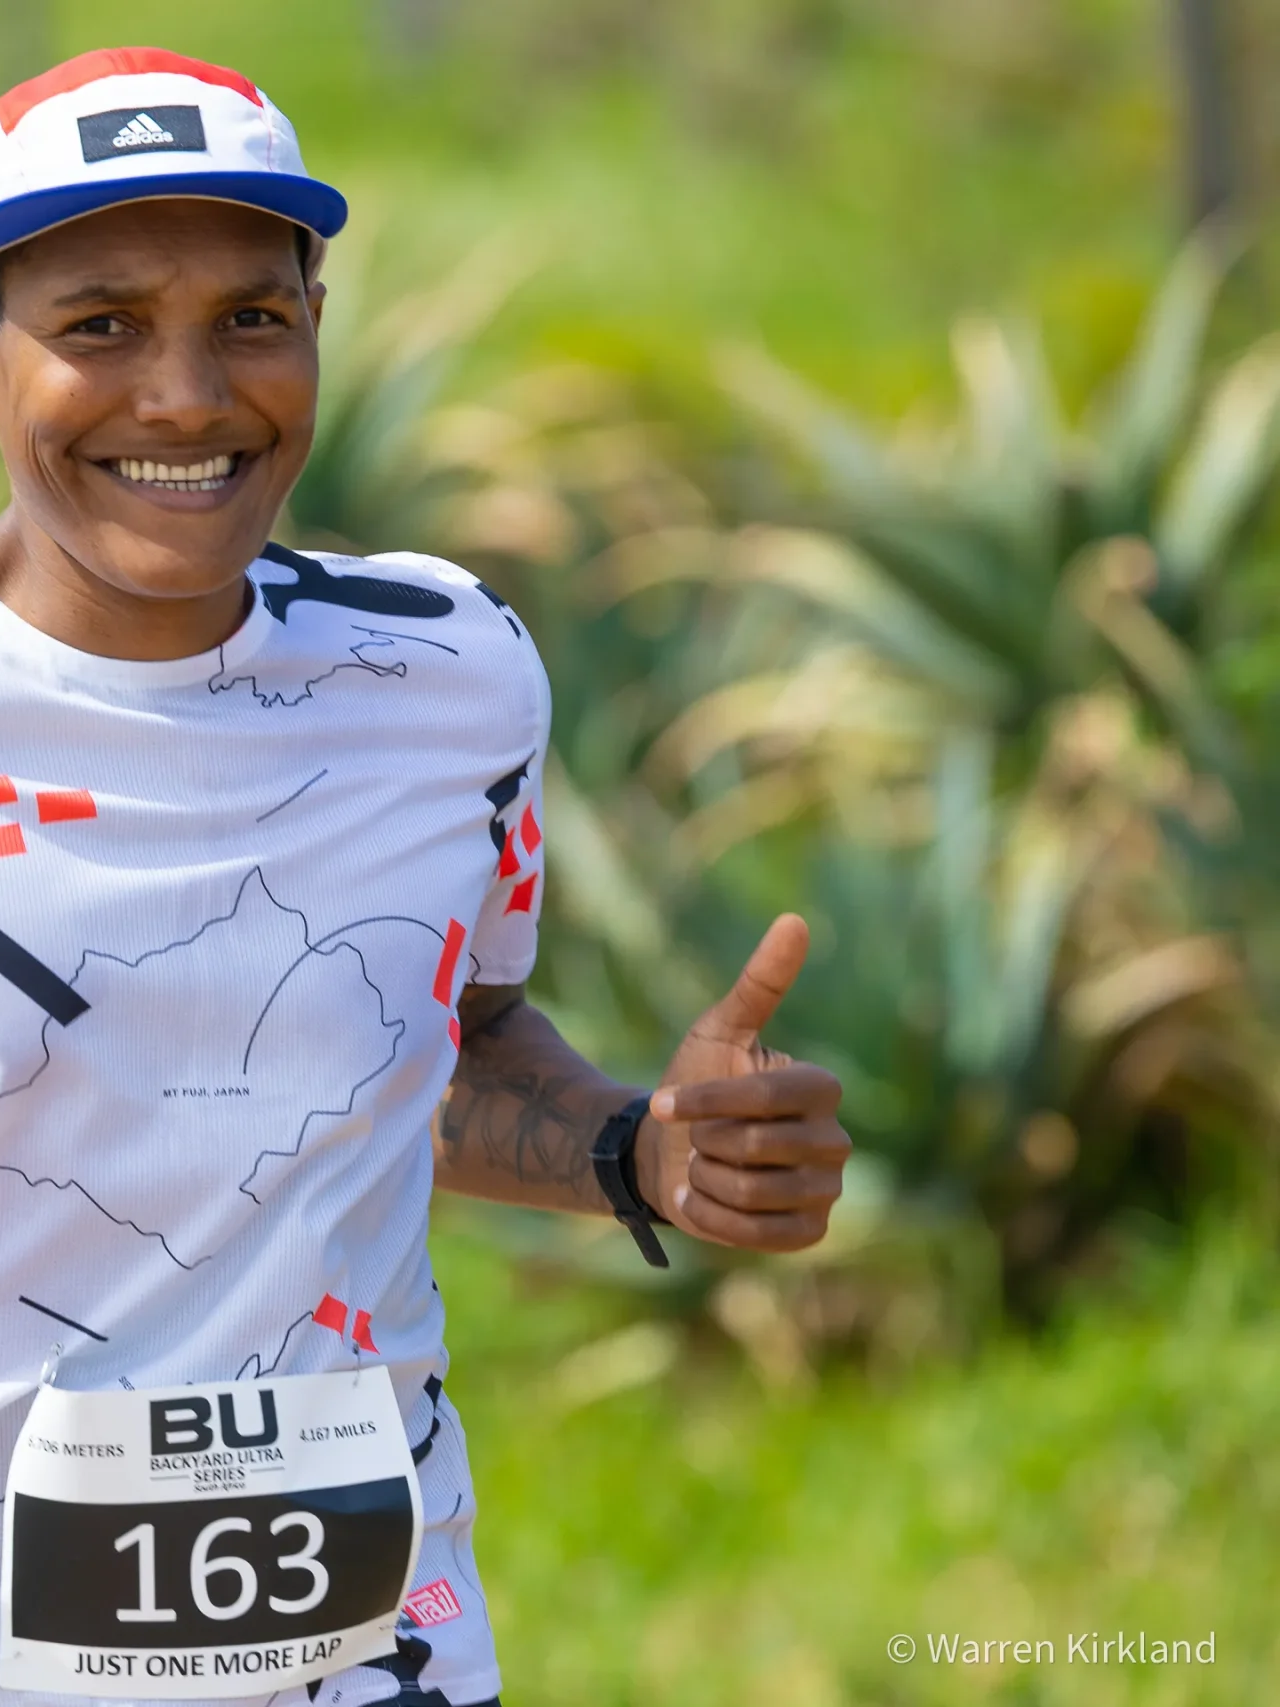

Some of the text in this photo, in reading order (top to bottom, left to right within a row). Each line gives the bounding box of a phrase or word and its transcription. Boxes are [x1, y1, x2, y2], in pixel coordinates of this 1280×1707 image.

[112, 131, 174, 147] adidas
[163, 1088, 178, 1098] MT
[214, 1086, 250, 1097] JAPAN
[150, 1389, 279, 1455] BU
[334, 1420, 377, 1438] MILES
[63, 1443, 125, 1458] METERS
[150, 1447, 284, 1470] BACKYARD ULTRA
[193, 1466, 246, 1482] SERIES
[114, 1511, 330, 1622] 163
[75, 1637, 342, 1677] JUST ONE MORE LAP
